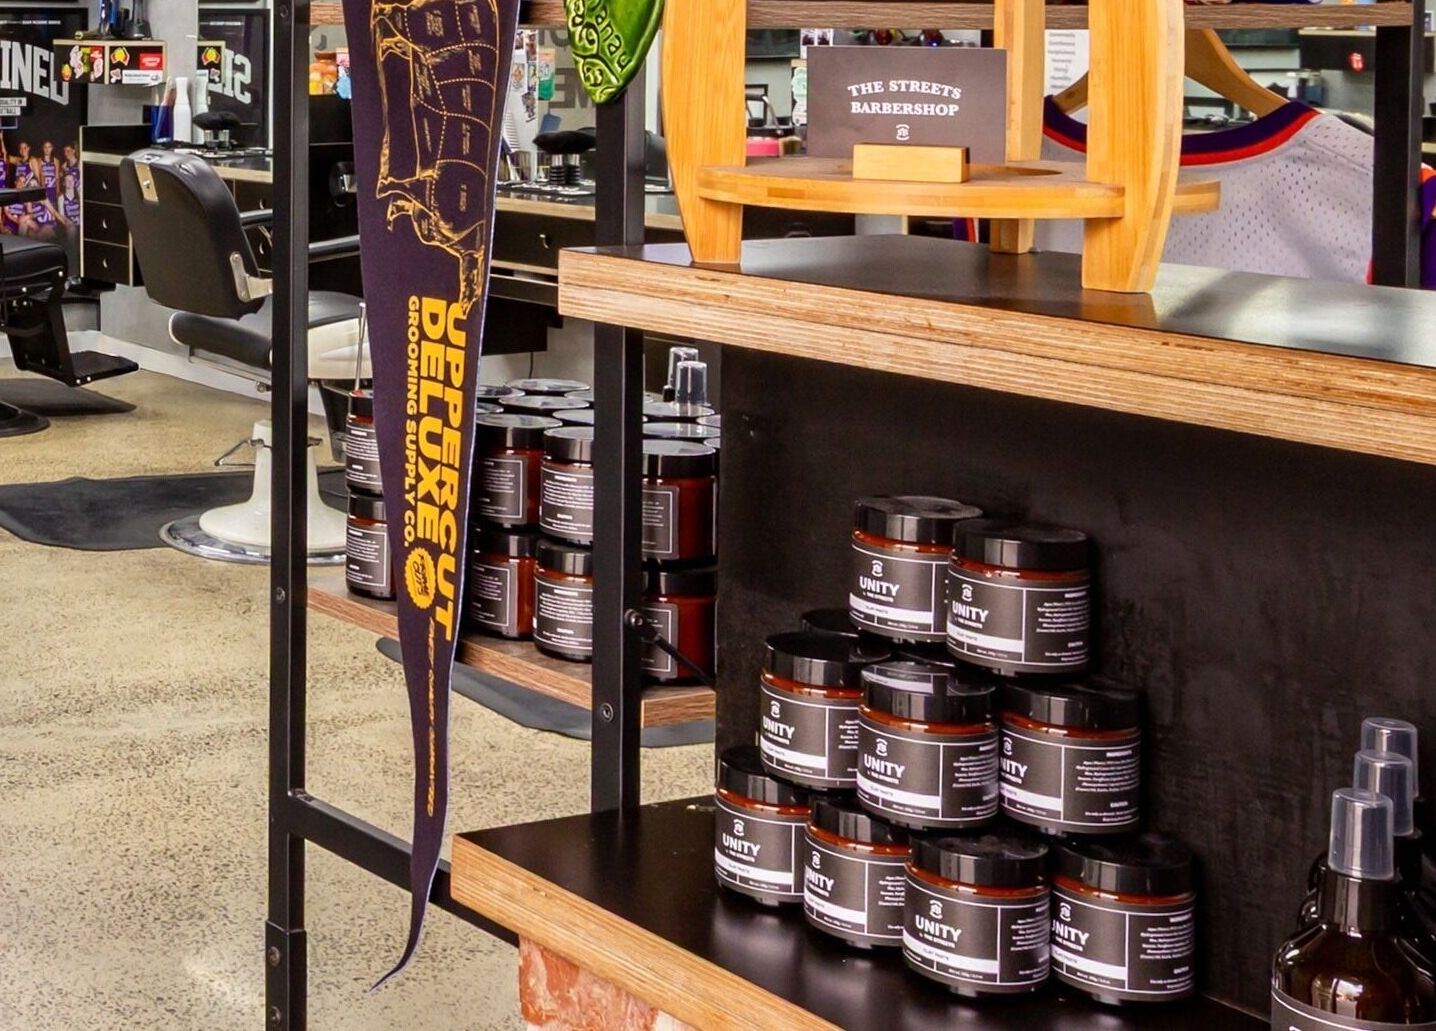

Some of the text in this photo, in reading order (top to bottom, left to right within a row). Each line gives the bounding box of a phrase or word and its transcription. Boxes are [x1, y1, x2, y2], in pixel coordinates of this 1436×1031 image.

[847, 79, 962, 100] THE STREETS
[851, 101, 960, 117] BARBERSHOP
[403, 295, 420, 548] GROOMING SUPPLY CO.
[416, 297, 447, 544] DELUXE
[436, 302, 466, 642] UPPERCUT
[859, 575, 900, 597] UNITY
[952, 600, 989, 623] UNITY
[762, 715, 795, 739] UNITY
[863, 753, 906, 779] UNITY
[999, 756, 1028, 778] NITY
[722, 832, 761, 857] UNITY
[915, 914, 962, 943] UNITY
